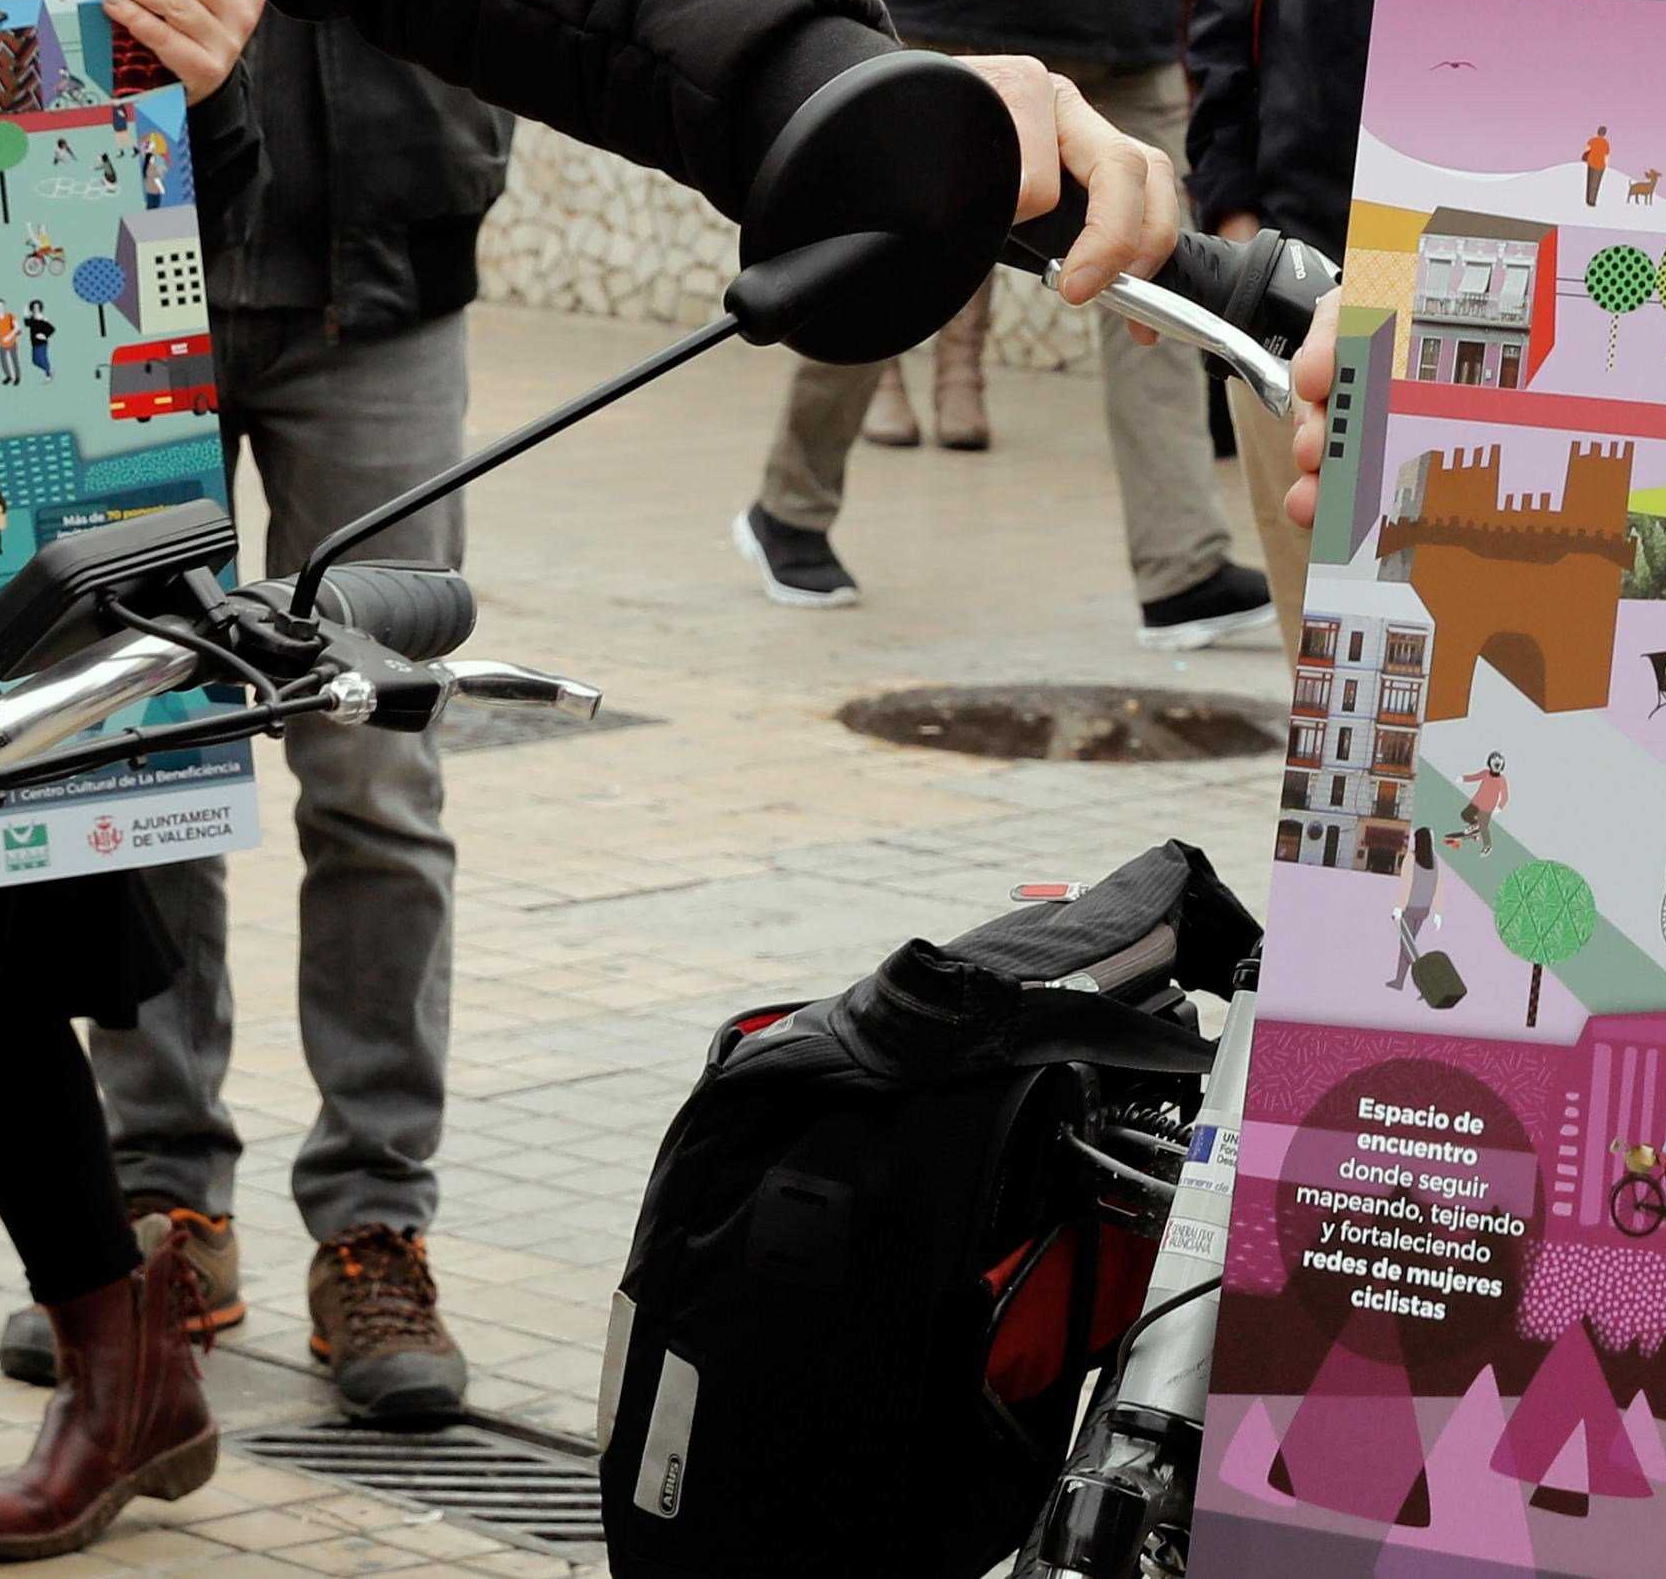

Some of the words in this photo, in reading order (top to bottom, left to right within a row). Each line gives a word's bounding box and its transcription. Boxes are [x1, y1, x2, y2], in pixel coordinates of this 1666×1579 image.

[66, 778, 117, 794] Cultural
[132, 807, 231, 832] AJUNTAMENT
[133, 834, 151, 848] DE
[1358, 1097, 1450, 1130] Espacio
[1453, 1111, 1484, 1135] de
[1357, 1133, 1478, 1166] encuentro
[1339, 1157, 1414, 1187] donde
[1418, 1174, 1489, 1199] seguir
[1296, 1186, 1424, 1223] mapeando,
[1431, 1204, 1525, 1236] tejiendo
[1320, 1221, 1336, 1243] y
[1340, 1219, 1491, 1263] fortaleciendo
[1303, 1250, 1368, 1276] redes
[1371, 1257, 1402, 1281] de
[1406, 1266, 1503, 1296] mujeres
[1351, 1285, 1446, 1320] ciclistas
